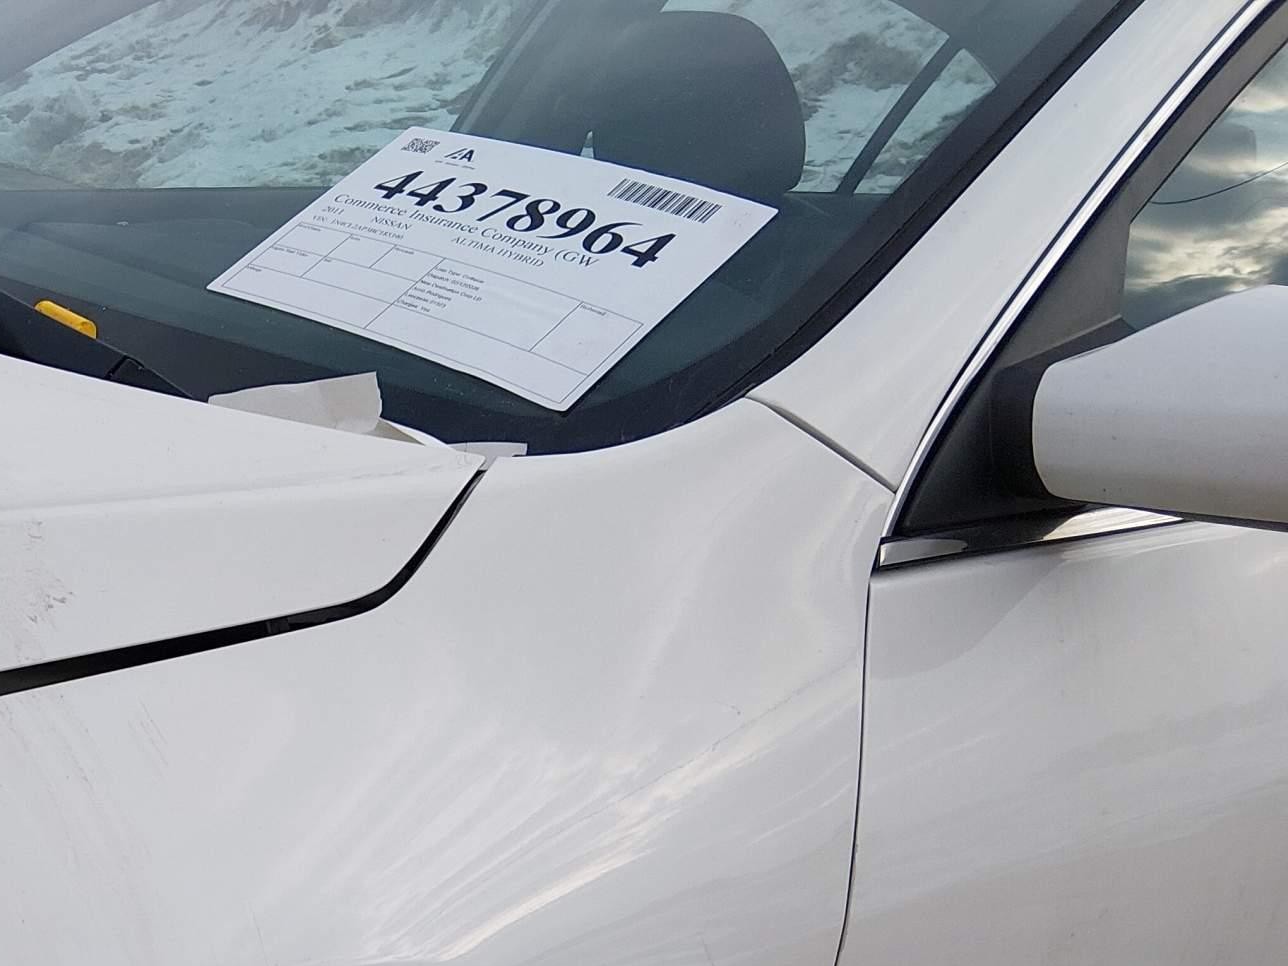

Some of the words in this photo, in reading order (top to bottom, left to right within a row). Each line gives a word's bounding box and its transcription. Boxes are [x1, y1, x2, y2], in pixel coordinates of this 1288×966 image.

[334, 194, 407, 216] Commerce
[409, 210, 478, 233] Insurance
[481, 227, 554, 255] Company
[554, 249, 599, 267] (GW
[372, 216, 412, 230] NISSAN
[451, 236, 495, 253] ALTIMA
[496, 248, 544, 267] HYBRID
[374, 170, 677, 268] 44378964
